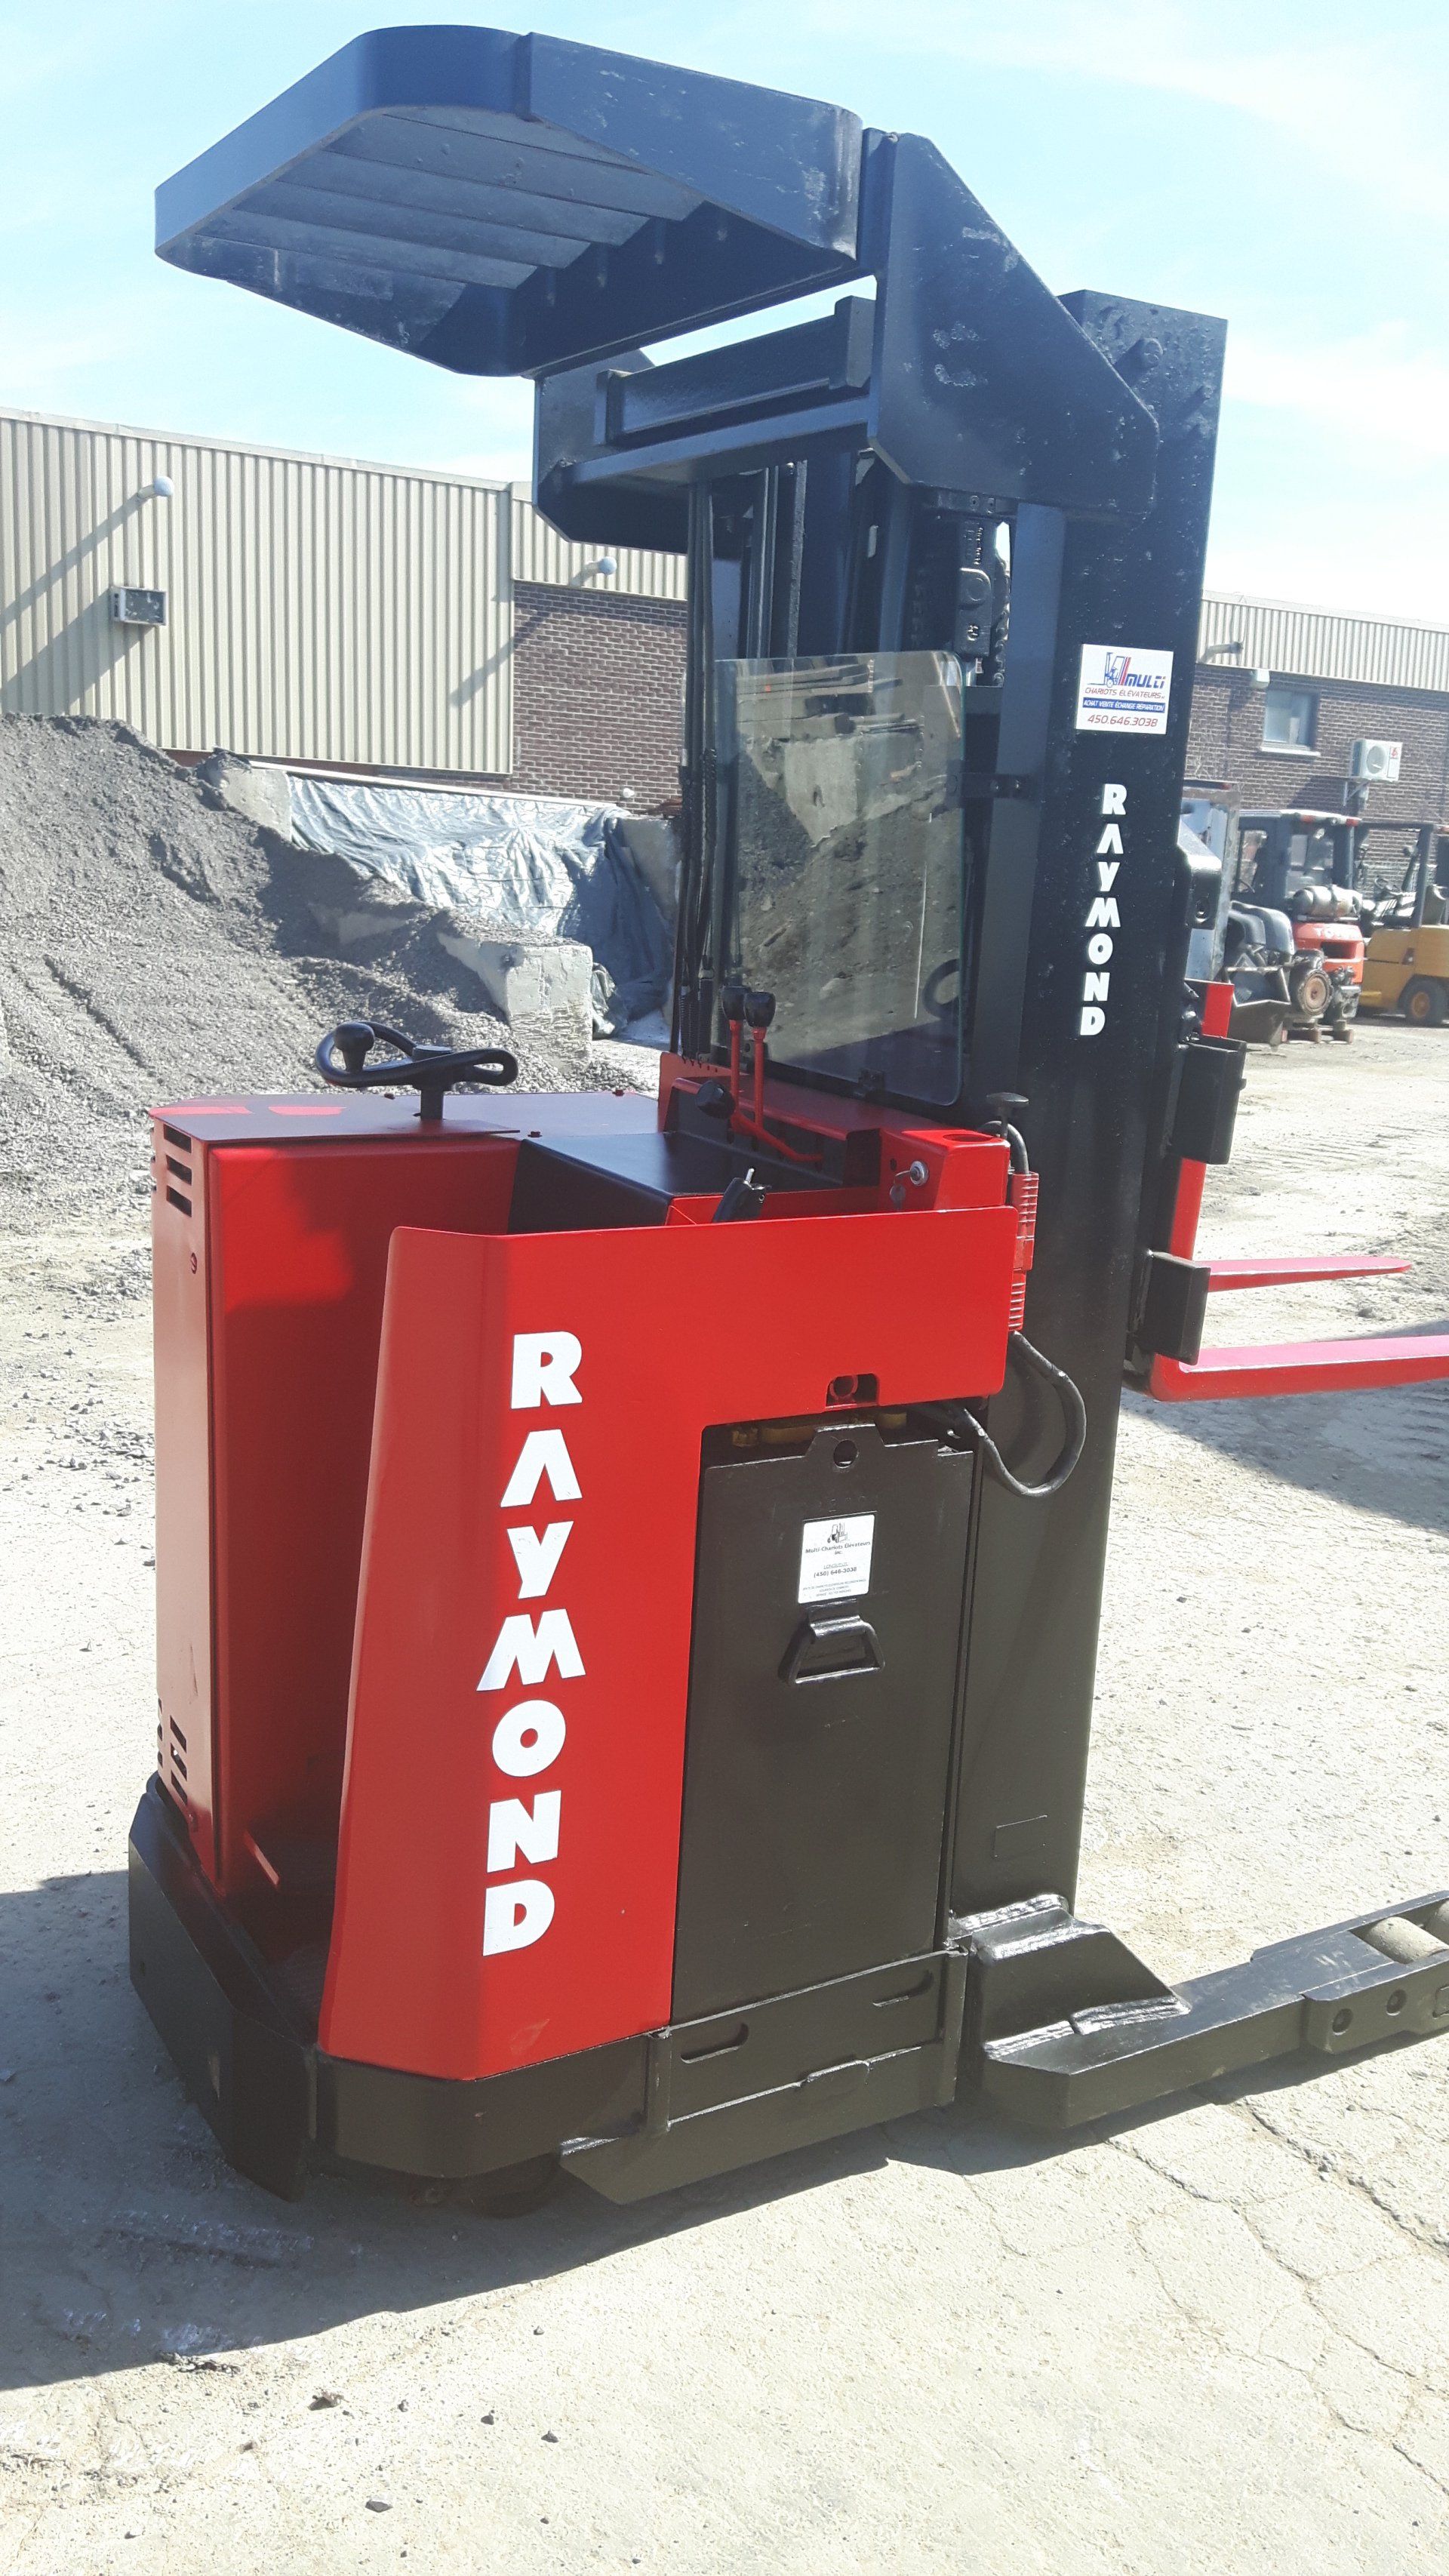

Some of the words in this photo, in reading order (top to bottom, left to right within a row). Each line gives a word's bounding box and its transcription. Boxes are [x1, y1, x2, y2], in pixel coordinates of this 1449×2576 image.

[1084, 688, 1117, 696] CHARIOTS
[1088, 714, 1158, 727] 450.646.3038
[1080, 783, 1127, 1036] RAYMOND
[830, 1567, 857, 1575] 646-3038
[476, 1331, 586, 1956] RAYMOND
